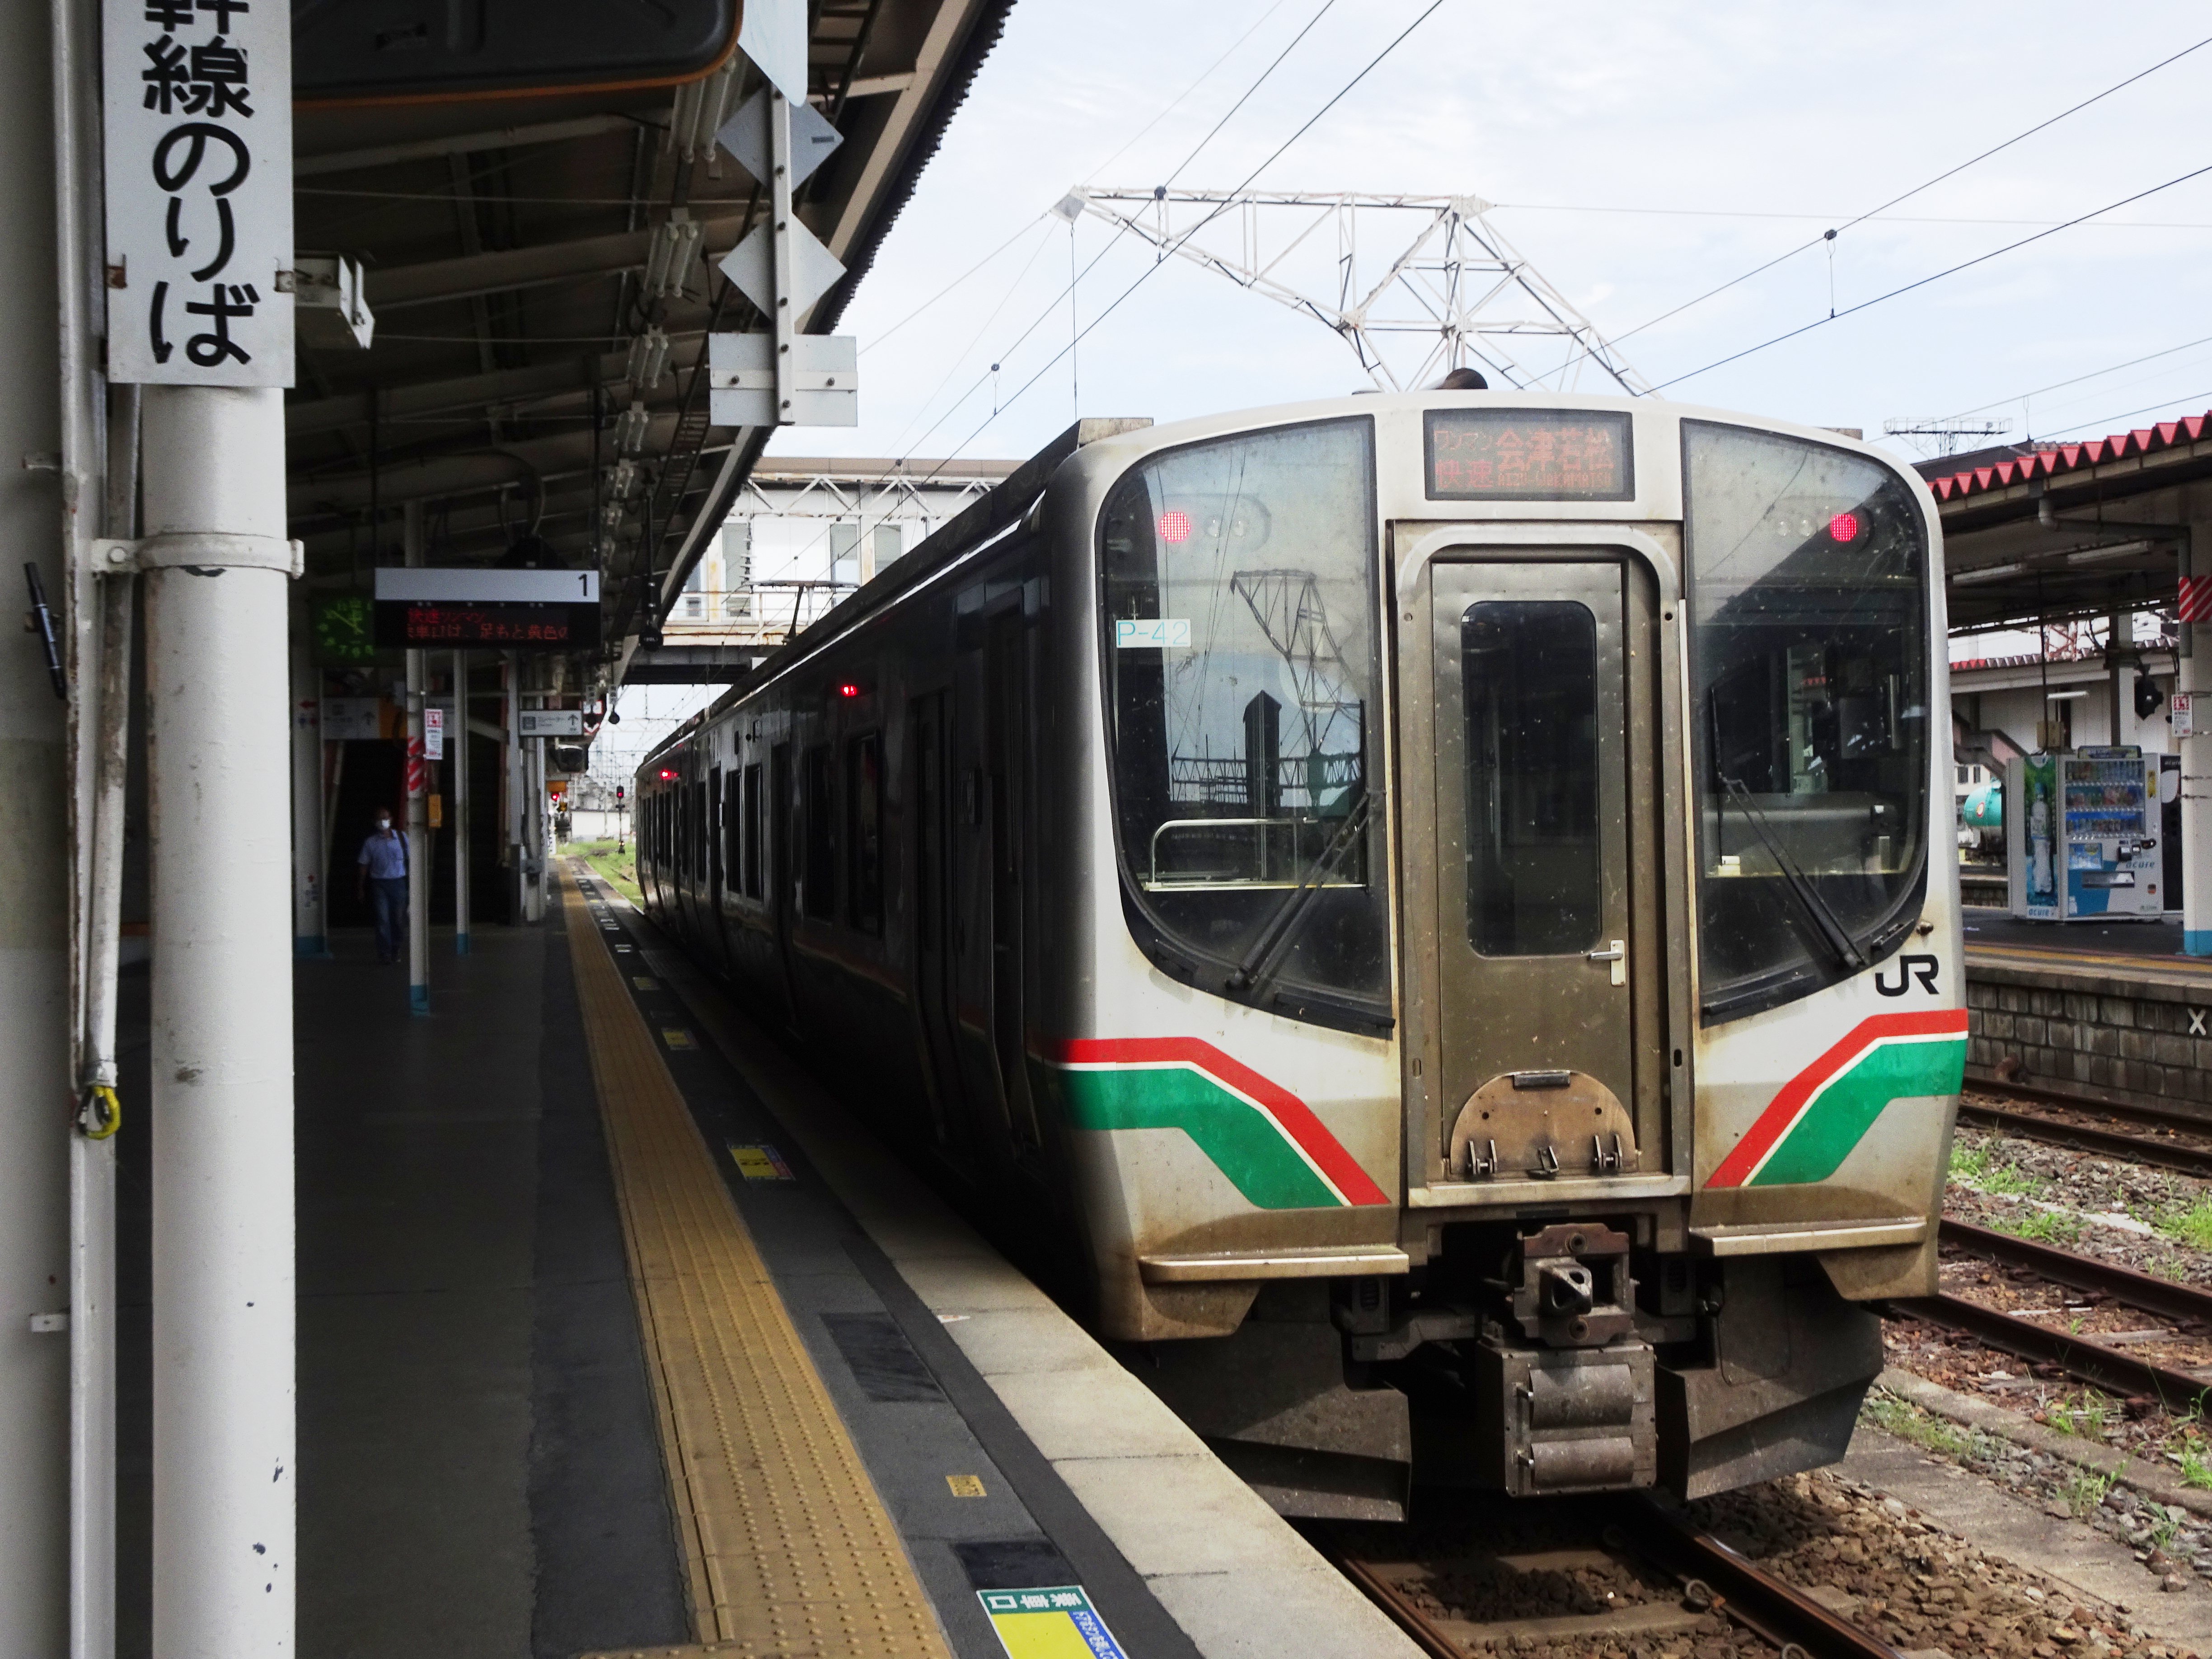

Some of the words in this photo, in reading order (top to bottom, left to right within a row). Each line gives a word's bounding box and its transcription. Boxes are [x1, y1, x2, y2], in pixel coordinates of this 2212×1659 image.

[1435, 459, 1493, 488] 快速
[578, 573, 587, 596] 1
[1117, 621, 1188, 646] P-42
[2125, 860, 2155, 869] acure
[1875, 954, 1940, 997] JR
